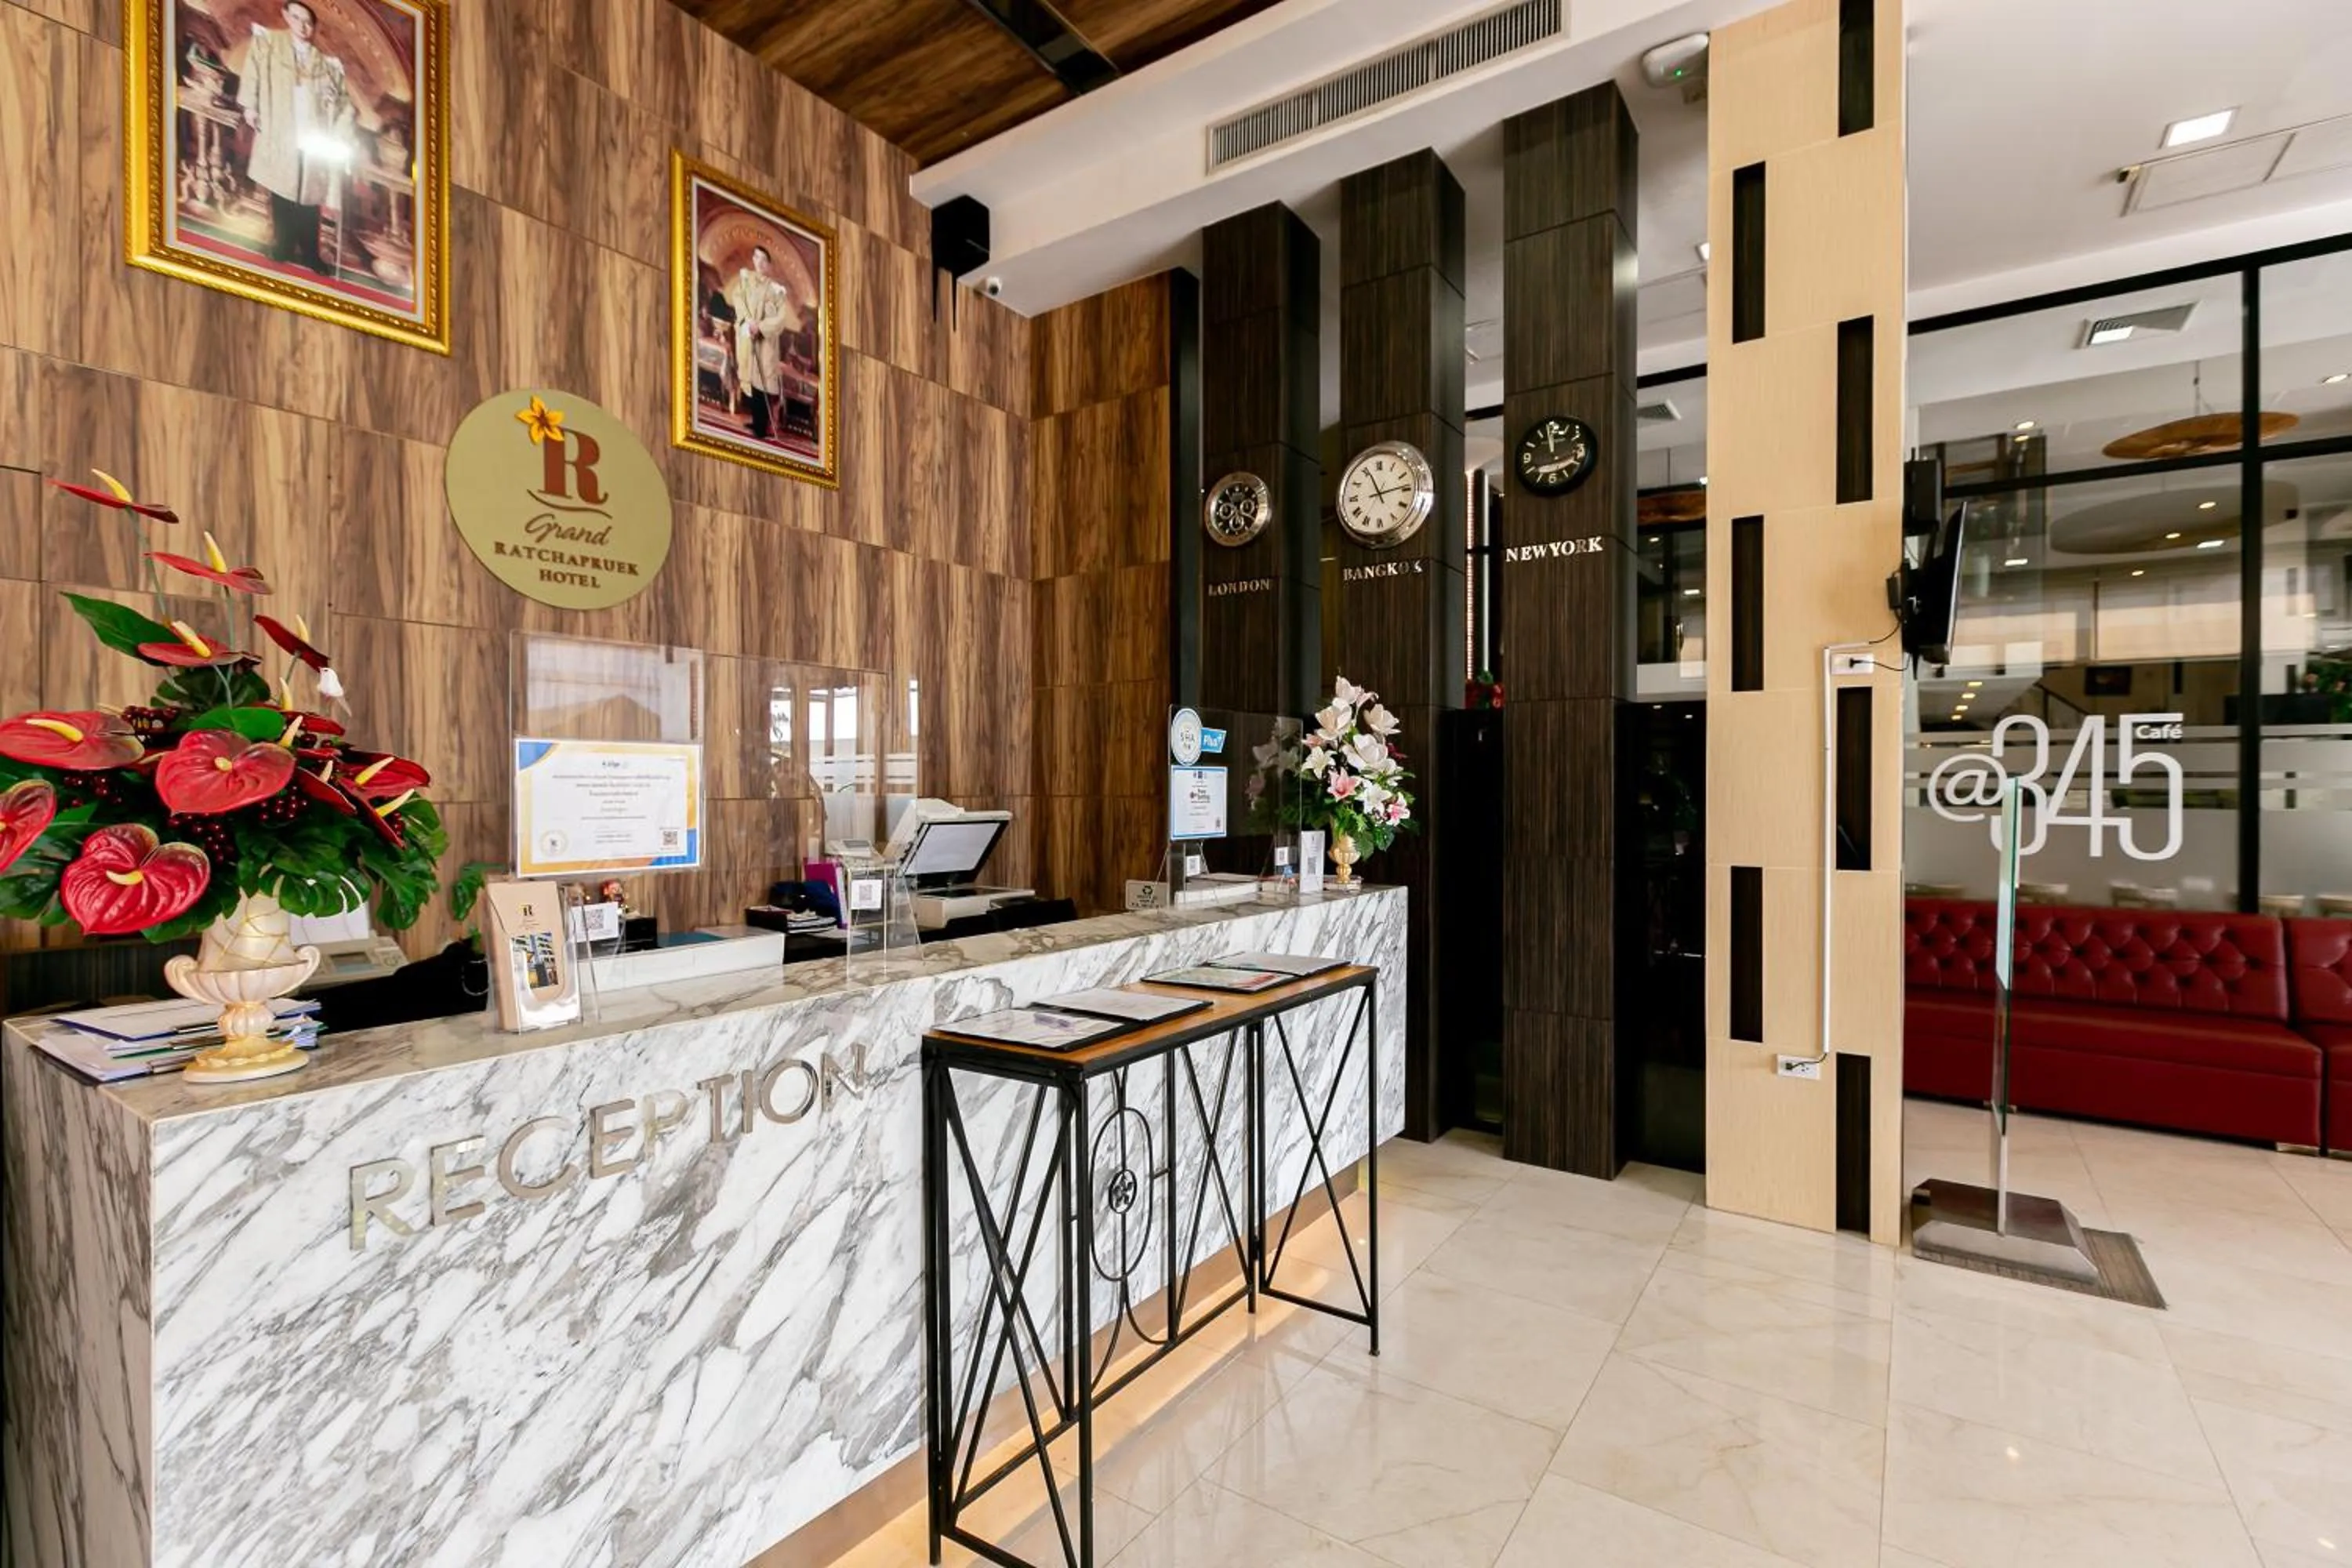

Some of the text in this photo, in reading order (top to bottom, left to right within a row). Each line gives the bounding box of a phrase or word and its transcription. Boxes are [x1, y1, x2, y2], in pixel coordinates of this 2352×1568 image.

[1523, 452, 1531, 463] 9
[1548, 474, 1556, 483] 6
[524, 514, 613, 546] Grand
[493, 541, 640, 576] RATCHAPRUEK
[539, 568, 601, 589] HOTEL
[1343, 560, 1423, 581] BANGKOK
[1208, 579, 1271, 597] LONDON
[2134, 724, 2183, 740] Café
[349, 1043, 868, 1250] RECEPTION
